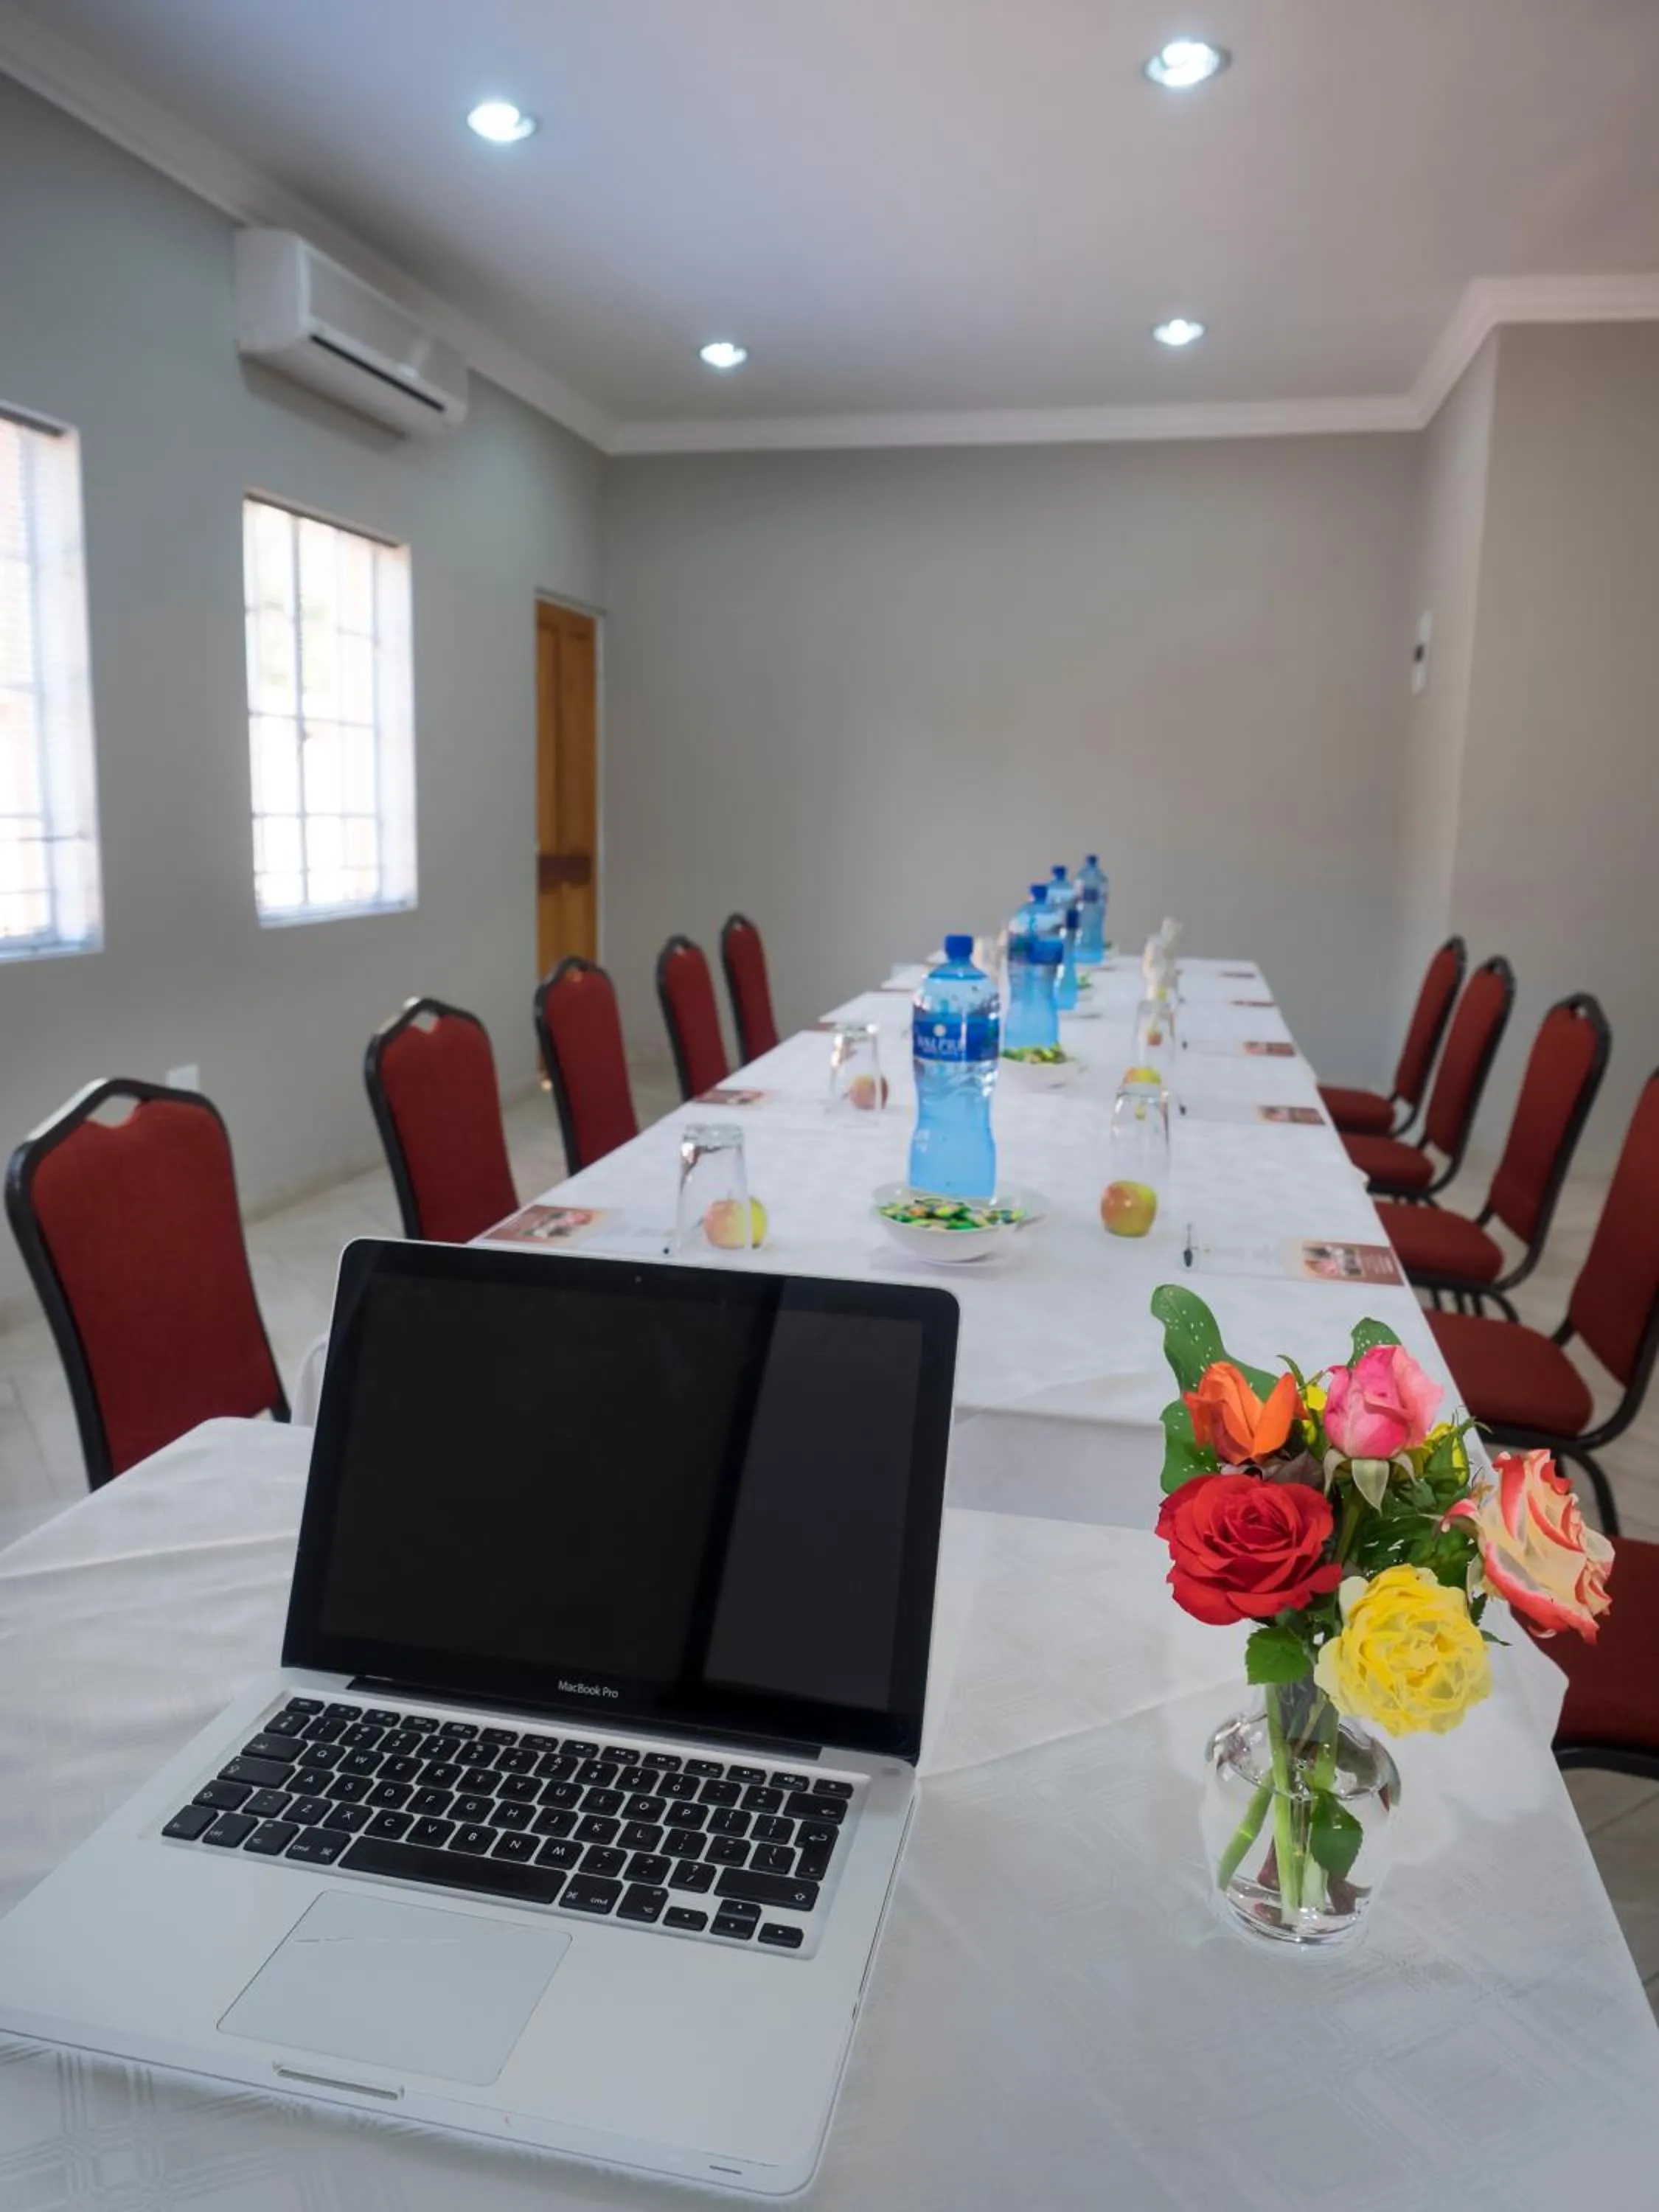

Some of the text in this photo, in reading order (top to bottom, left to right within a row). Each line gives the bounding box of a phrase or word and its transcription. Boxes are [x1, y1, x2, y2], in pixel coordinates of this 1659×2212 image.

[558, 1680, 619, 1698] MacBook Pro
[303, 1775, 314, 1783] A
[344, 1781, 355, 1792] S
[383, 1788, 395, 1798] D
[425, 1795, 436, 1804] F
[507, 1809, 518, 1818] H
[549, 1816, 559, 1824] J
[592, 1823, 602, 1832] K
[636, 1829, 644, 1839] L
[316, 1750, 327, 1758] Q
[355, 1756, 368, 1764] W
[395, 1762, 406, 1770] E
[555, 1788, 566, 1797] U
[639, 1801, 650, 1811] O
[301, 1804, 313, 1814] Z
[341, 1810, 354, 1820] X
[383, 1818, 395, 1827] C
[428, 1824, 437, 1834] V
[467, 1832, 479, 1841] B
[509, 1840, 522, 1849] N
[552, 1846, 566, 1857] M
[591, 1897, 608, 1906] cmd
